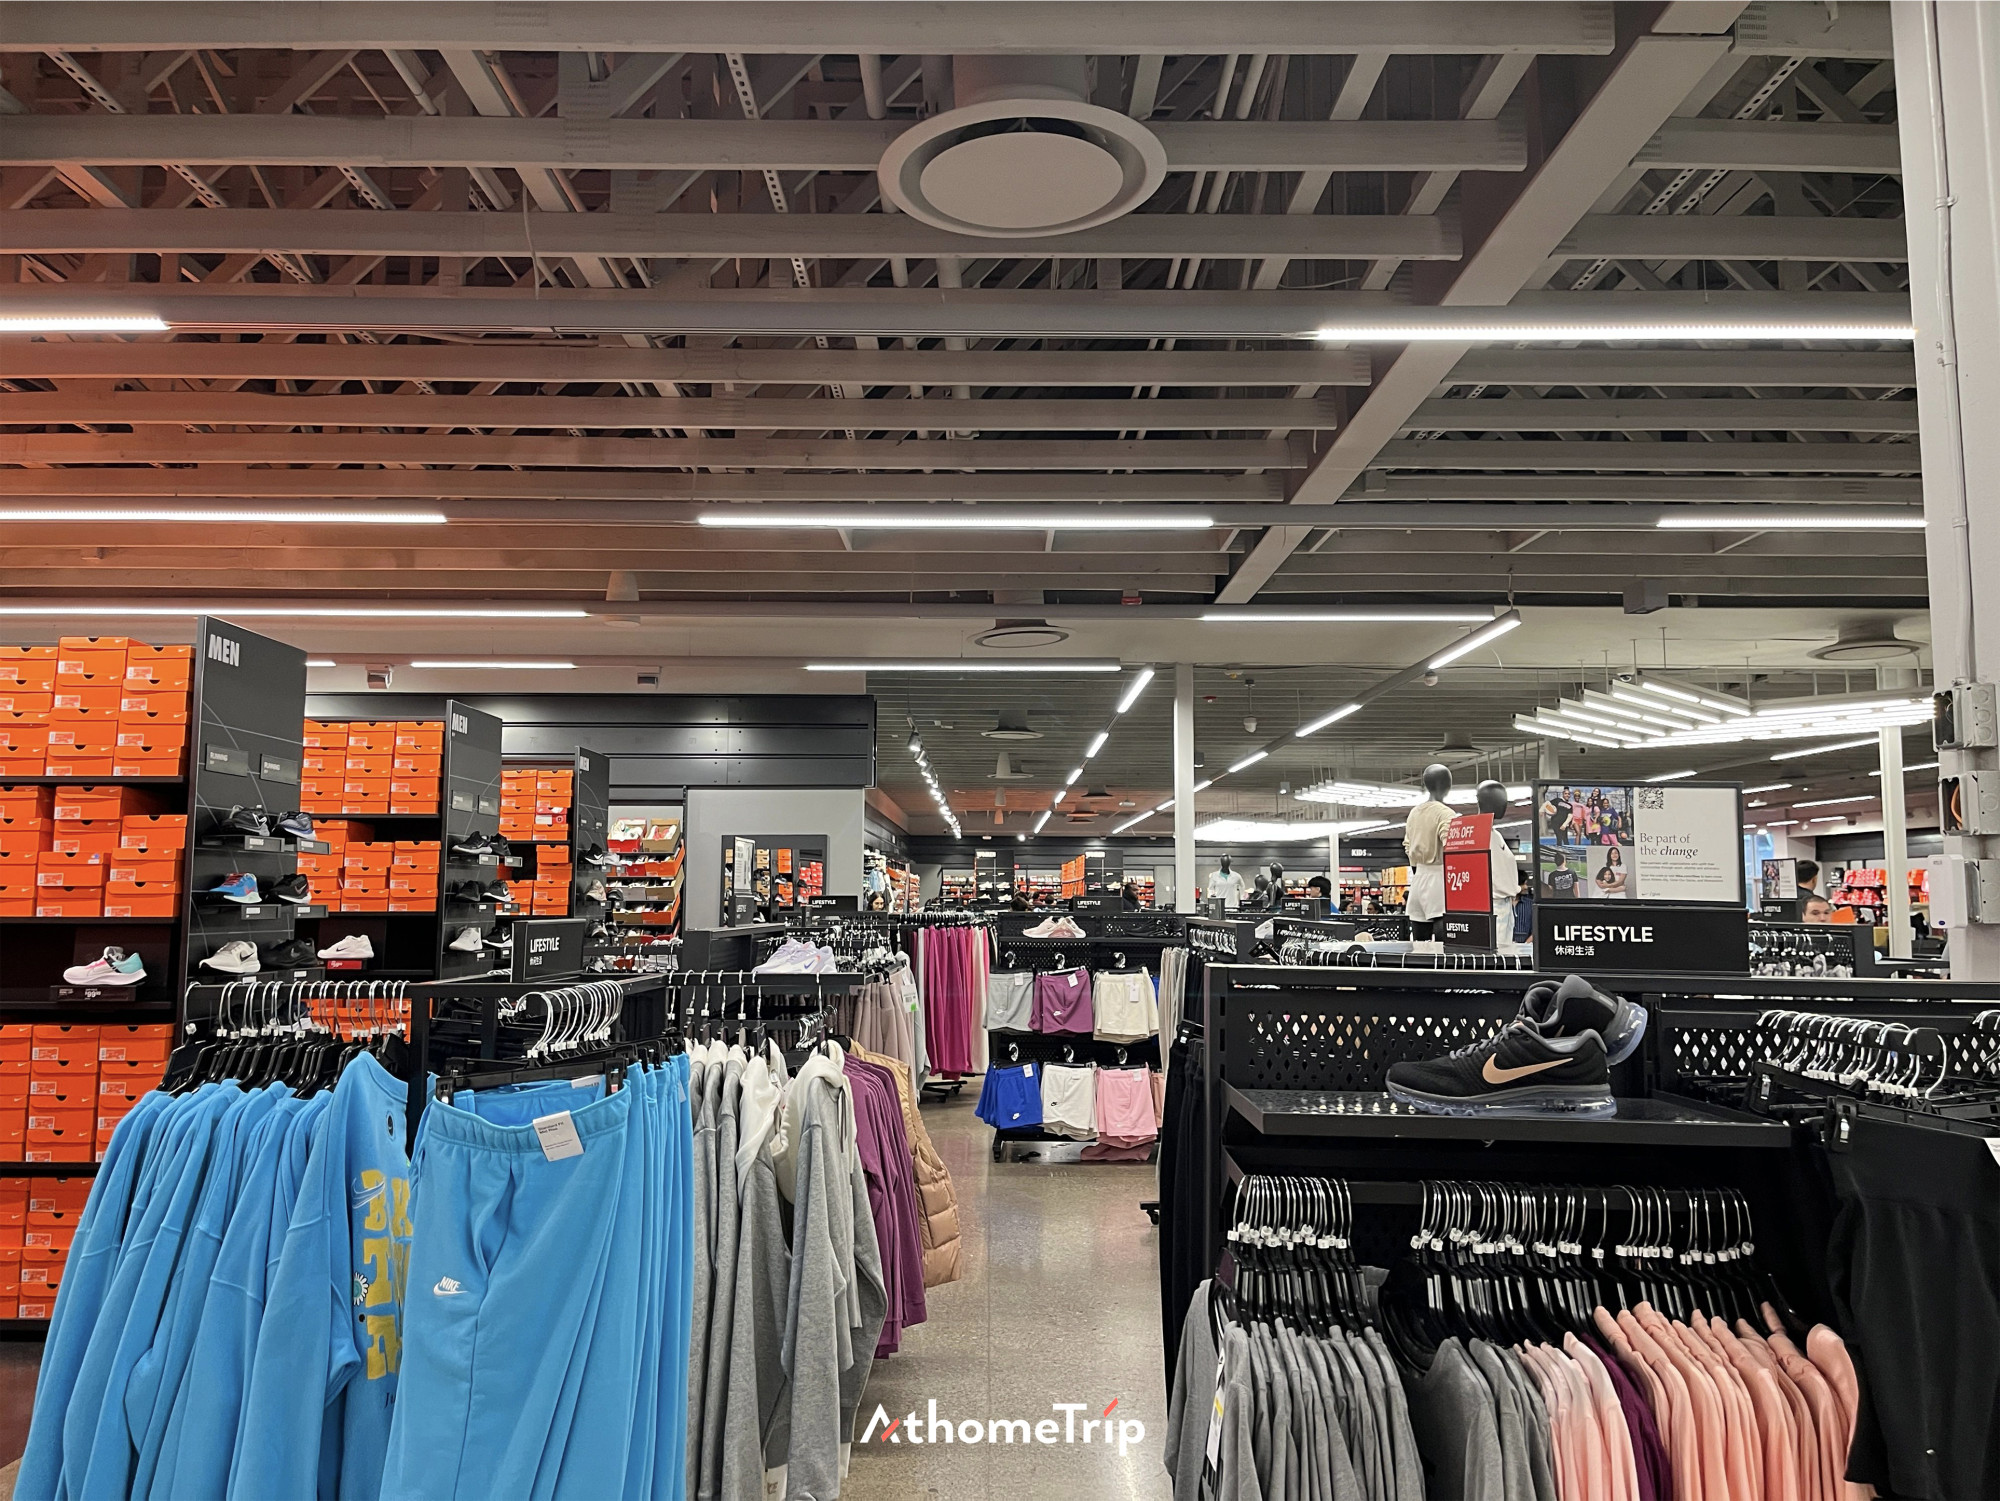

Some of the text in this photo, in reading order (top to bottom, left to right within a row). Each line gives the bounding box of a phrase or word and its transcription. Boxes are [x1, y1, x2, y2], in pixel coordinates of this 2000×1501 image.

[208, 634, 240, 667] MEN
[452, 713, 468, 735] MEN
[1448, 826, 1475, 840] 30% OFF
[1640, 833, 1691, 846] Be part of
[1352, 849, 1366, 857] KIDS
[1640, 845, 1699, 859] the change
[1446, 923, 1469, 932] LIFESTYLE
[1553, 925, 1654, 943] LIFESTYLE
[530, 936, 560, 953] LIFESTYLE
[1554, 945, 1595, 956] 休闲生活
[440, 1275, 461, 1292] NIKE
